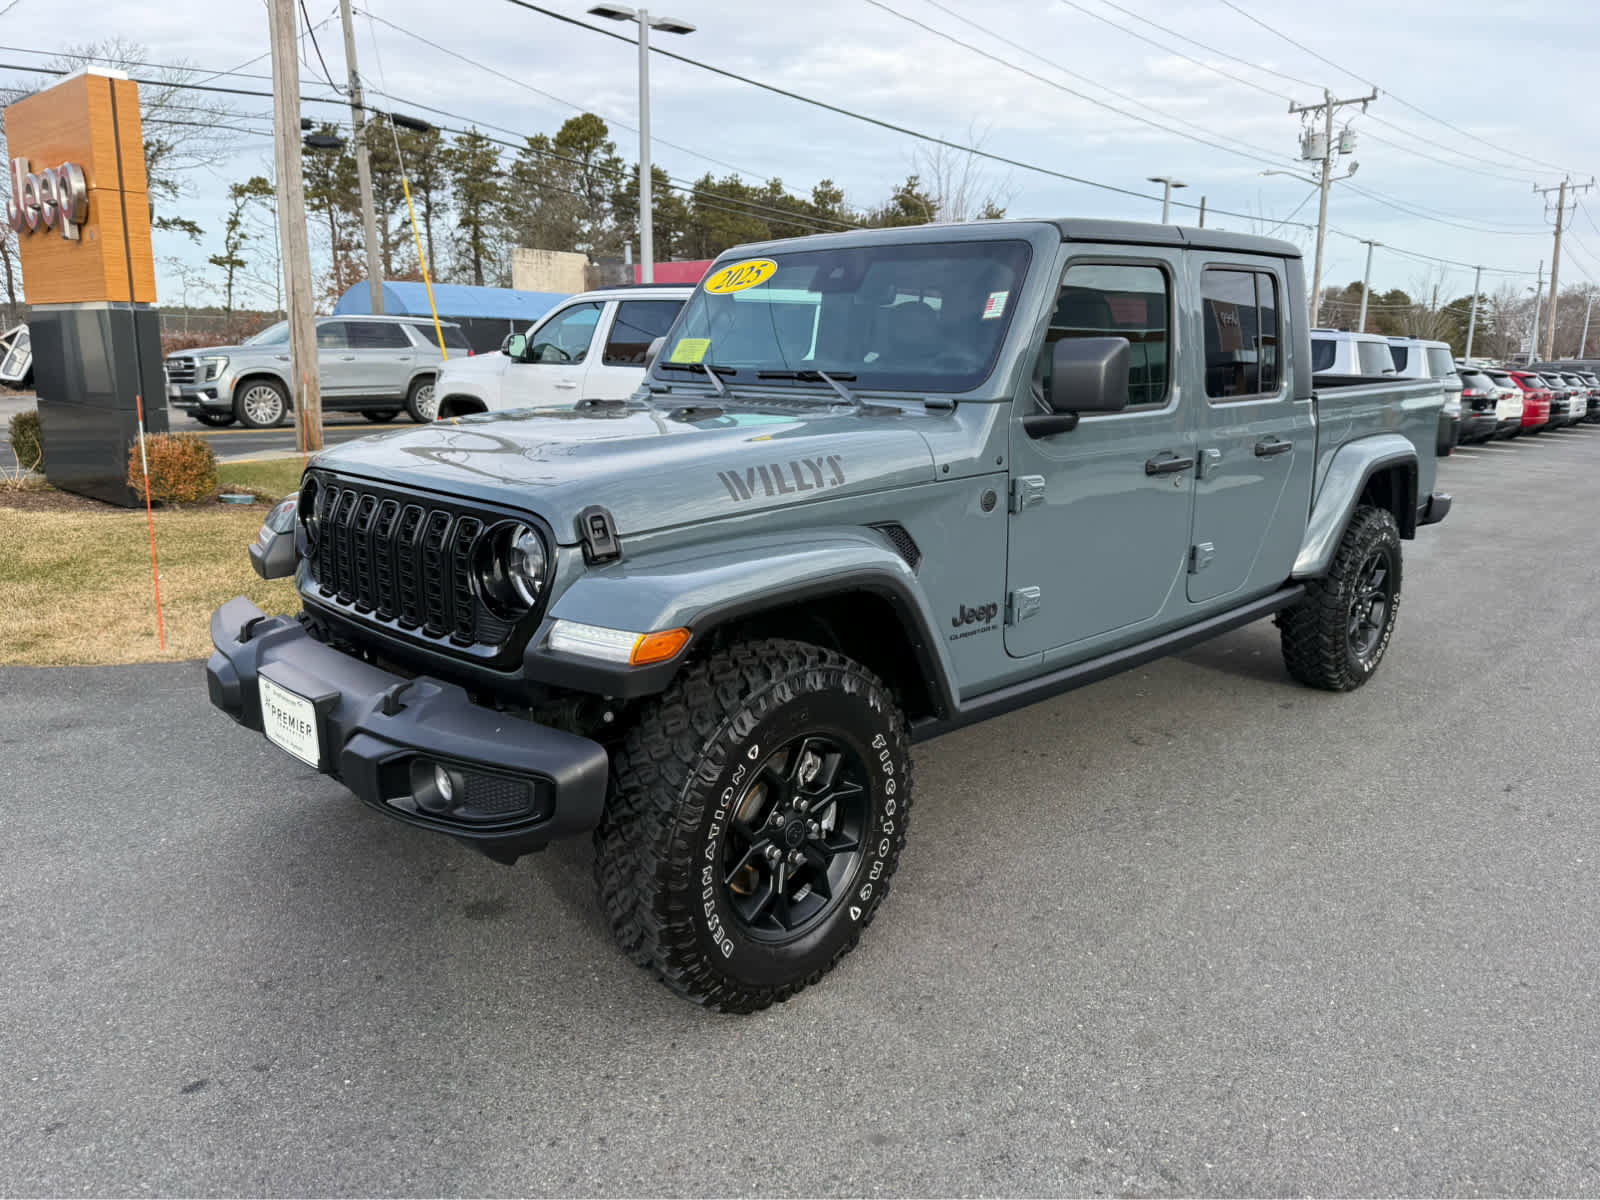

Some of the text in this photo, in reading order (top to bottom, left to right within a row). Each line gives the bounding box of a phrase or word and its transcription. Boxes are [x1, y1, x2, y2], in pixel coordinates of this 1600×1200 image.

[8, 157, 88, 240] Jeep
[714, 263, 769, 290] 2025
[716, 455, 846, 502] WILLYS
[951, 602, 998, 628] Jeep
[271, 704, 312, 736] PREMIER
[859, 733, 896, 900] Firestone
[702, 764, 746, 959] DESTINATION
